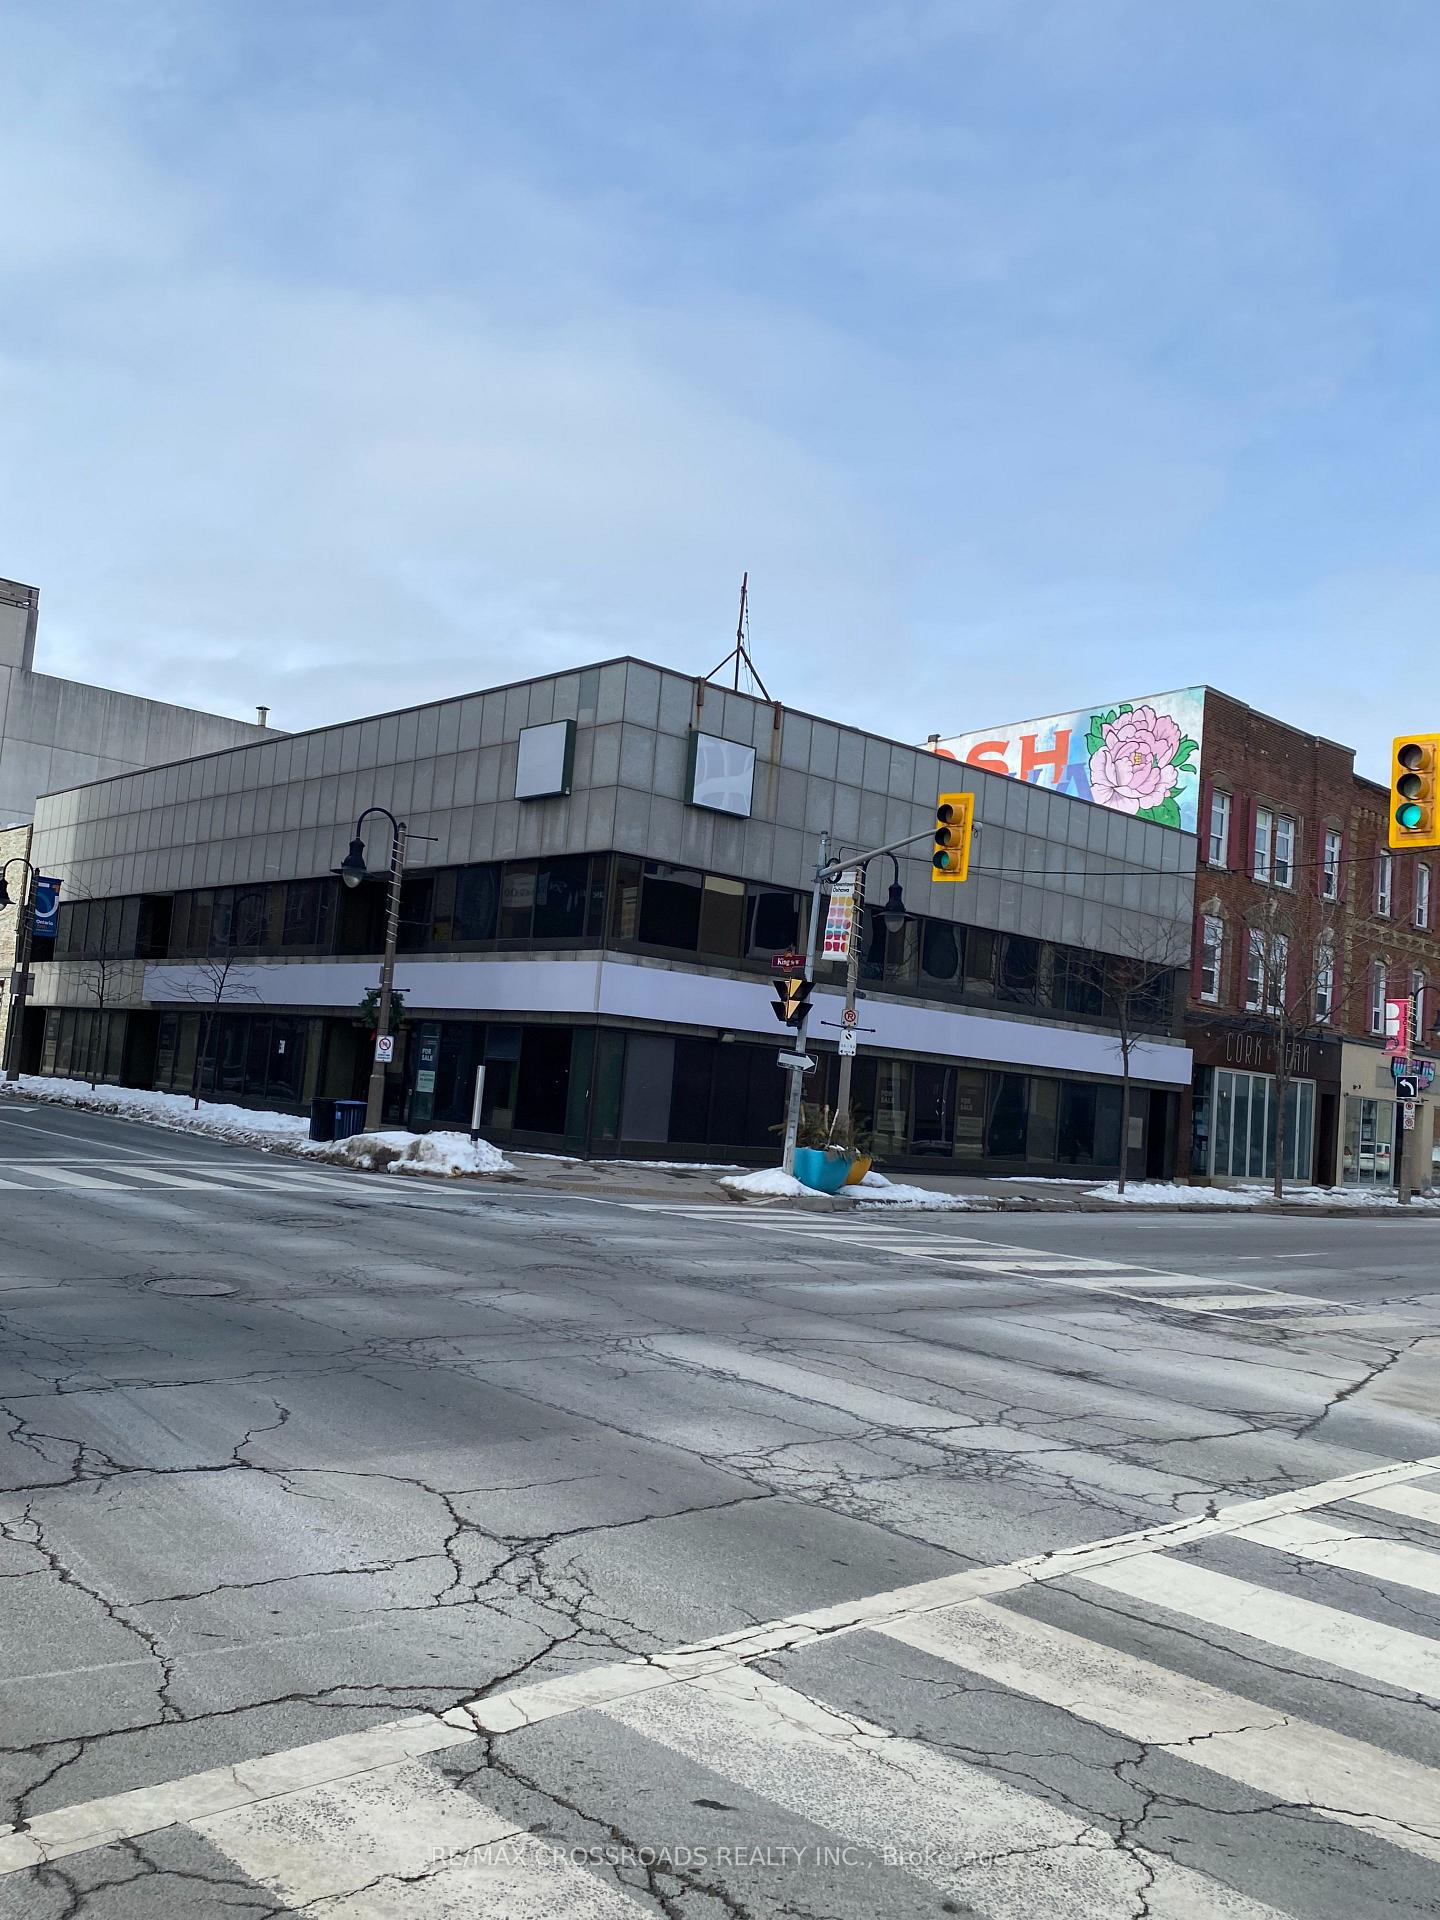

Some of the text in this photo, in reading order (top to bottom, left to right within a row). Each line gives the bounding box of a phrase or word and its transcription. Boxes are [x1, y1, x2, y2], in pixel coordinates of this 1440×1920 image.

[777, 957, 791, 967] King
[1226, 1032, 1262, 1066] CORK
[1277, 1042, 1310, 1073] EAN
